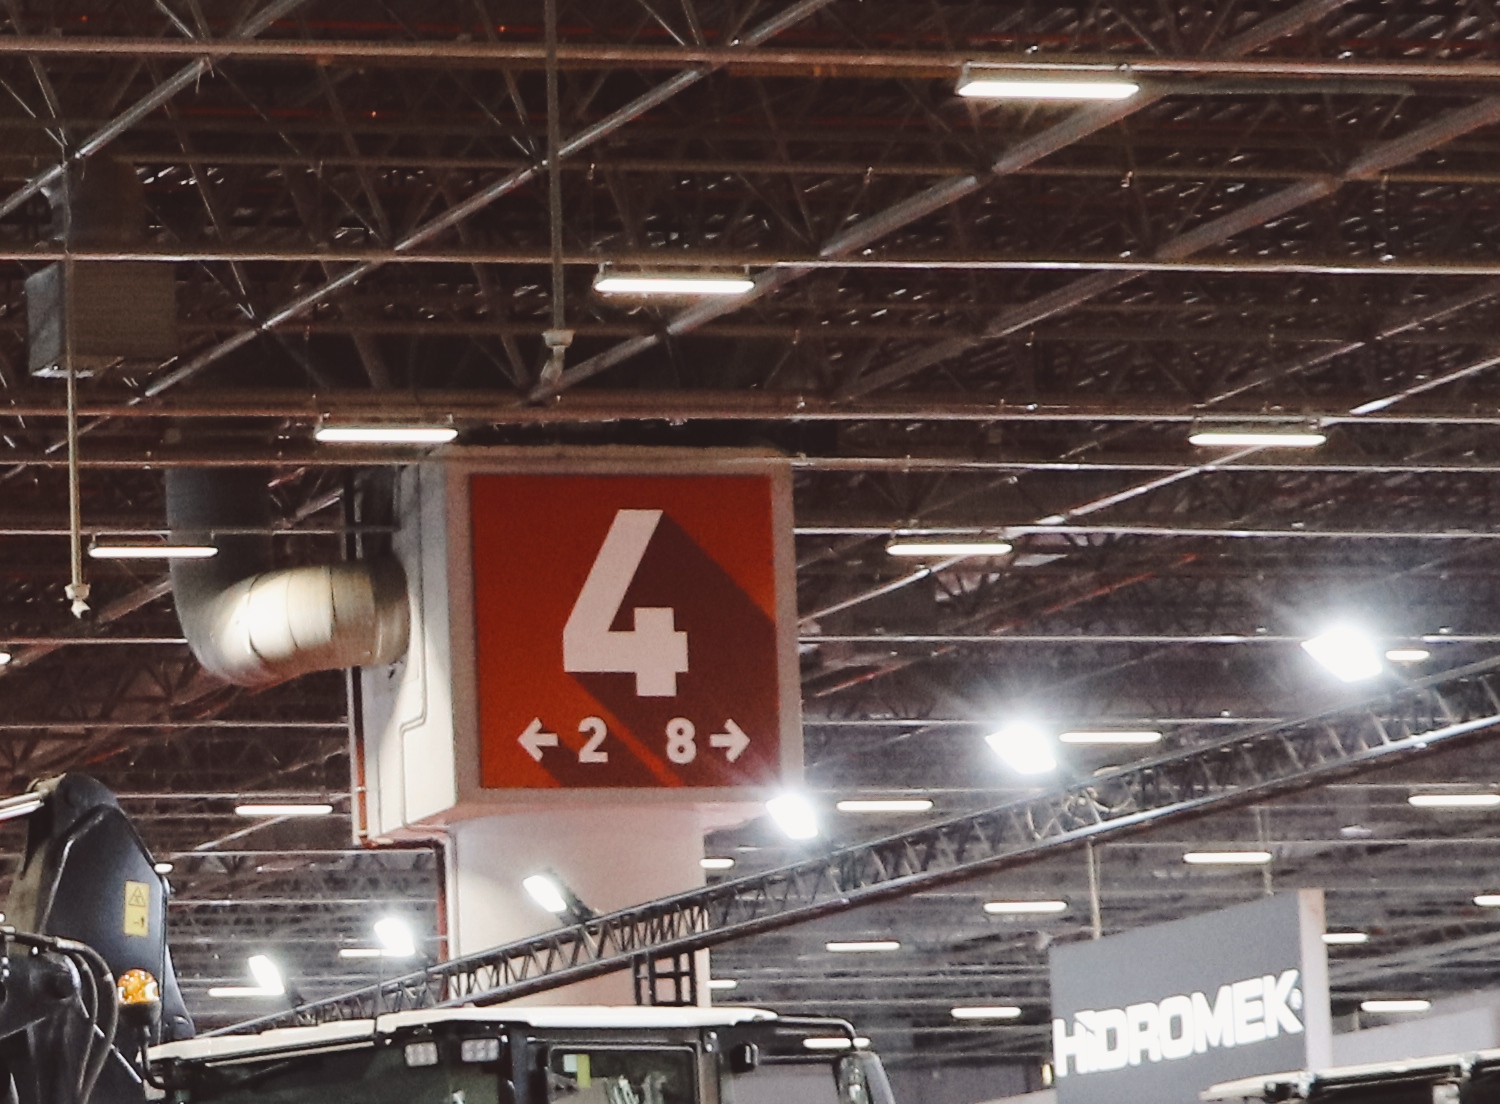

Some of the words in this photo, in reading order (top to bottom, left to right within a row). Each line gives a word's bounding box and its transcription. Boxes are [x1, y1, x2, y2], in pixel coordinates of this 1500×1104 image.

[562, 508, 689, 697] 4
[578, 717, 609, 763] 2
[666, 718, 696, 764] 8
